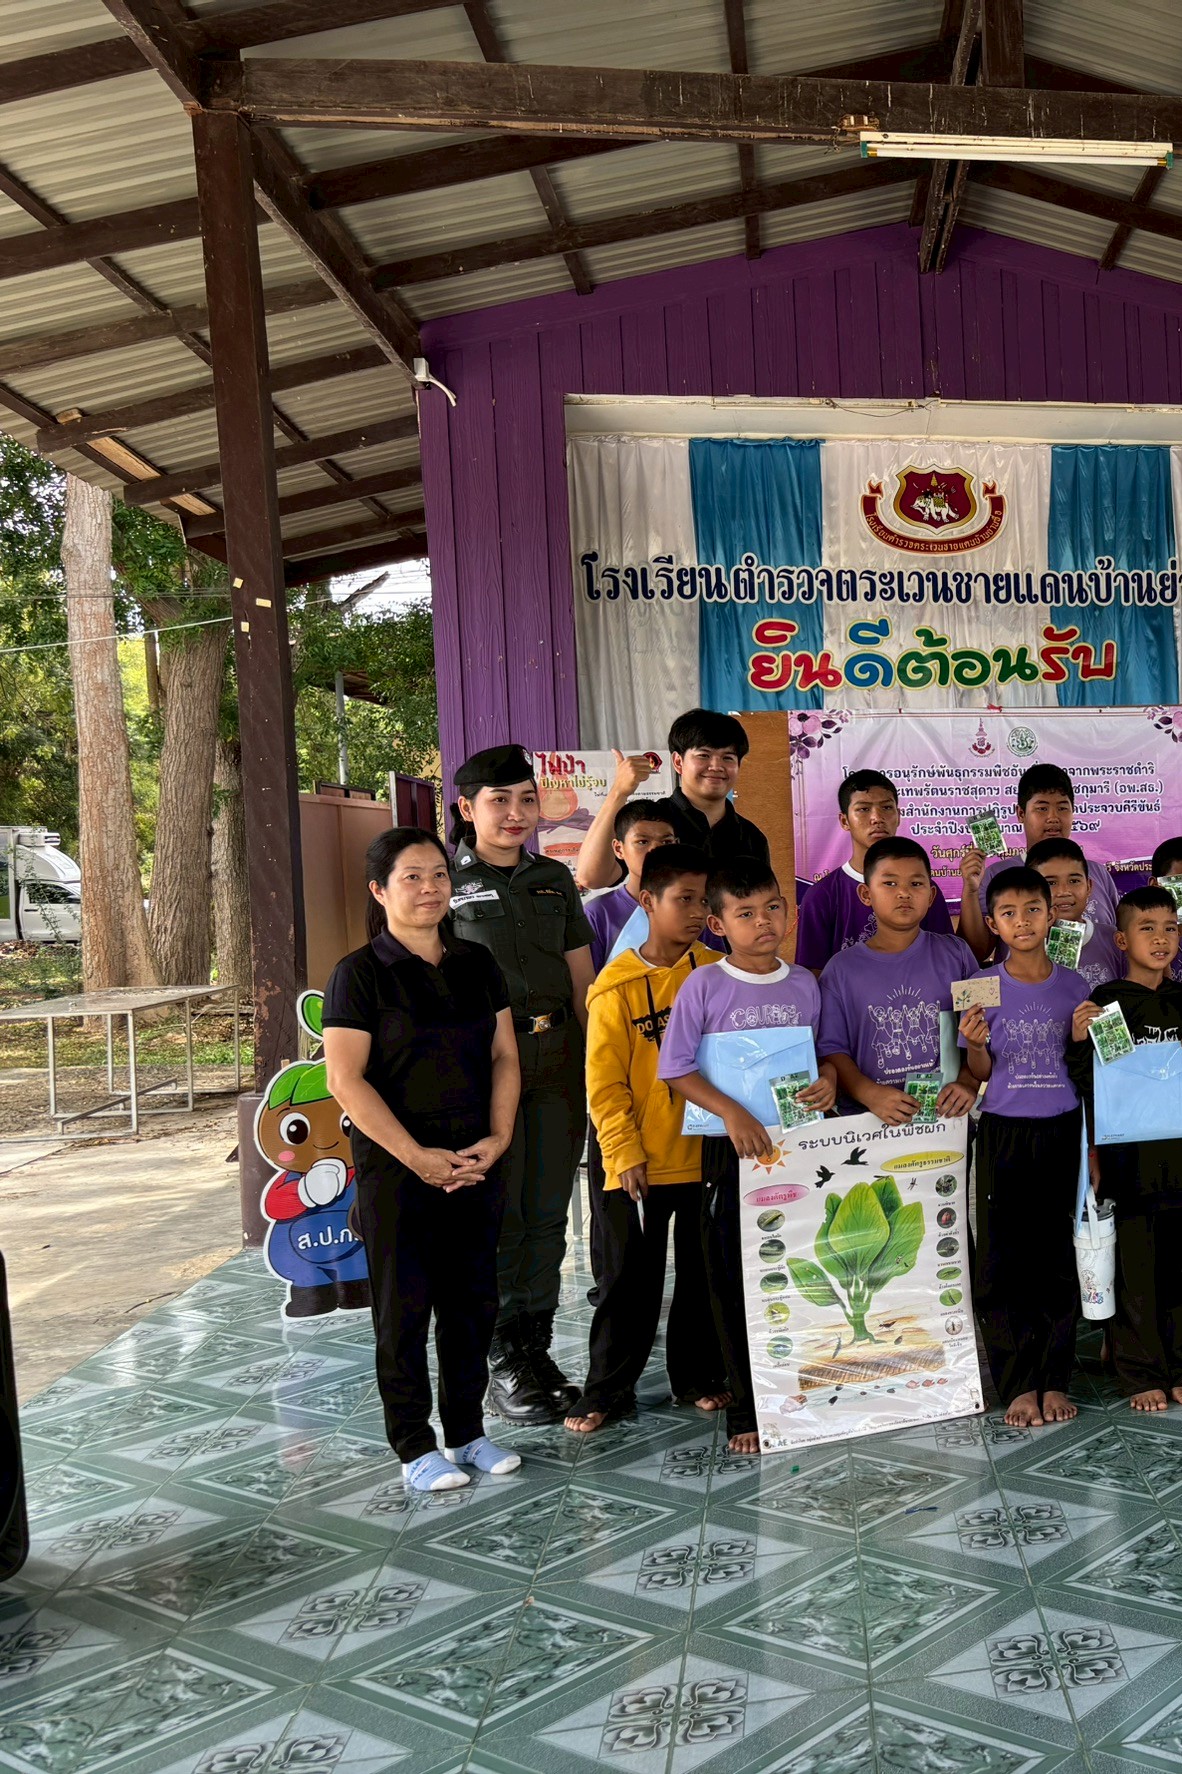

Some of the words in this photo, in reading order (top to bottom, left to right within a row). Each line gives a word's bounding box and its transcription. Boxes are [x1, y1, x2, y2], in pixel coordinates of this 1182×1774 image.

[748, 616, 1118, 691] ยินดีต้อนรับ
[1114, 780, 1164, 795] (อพ.สธ.)
